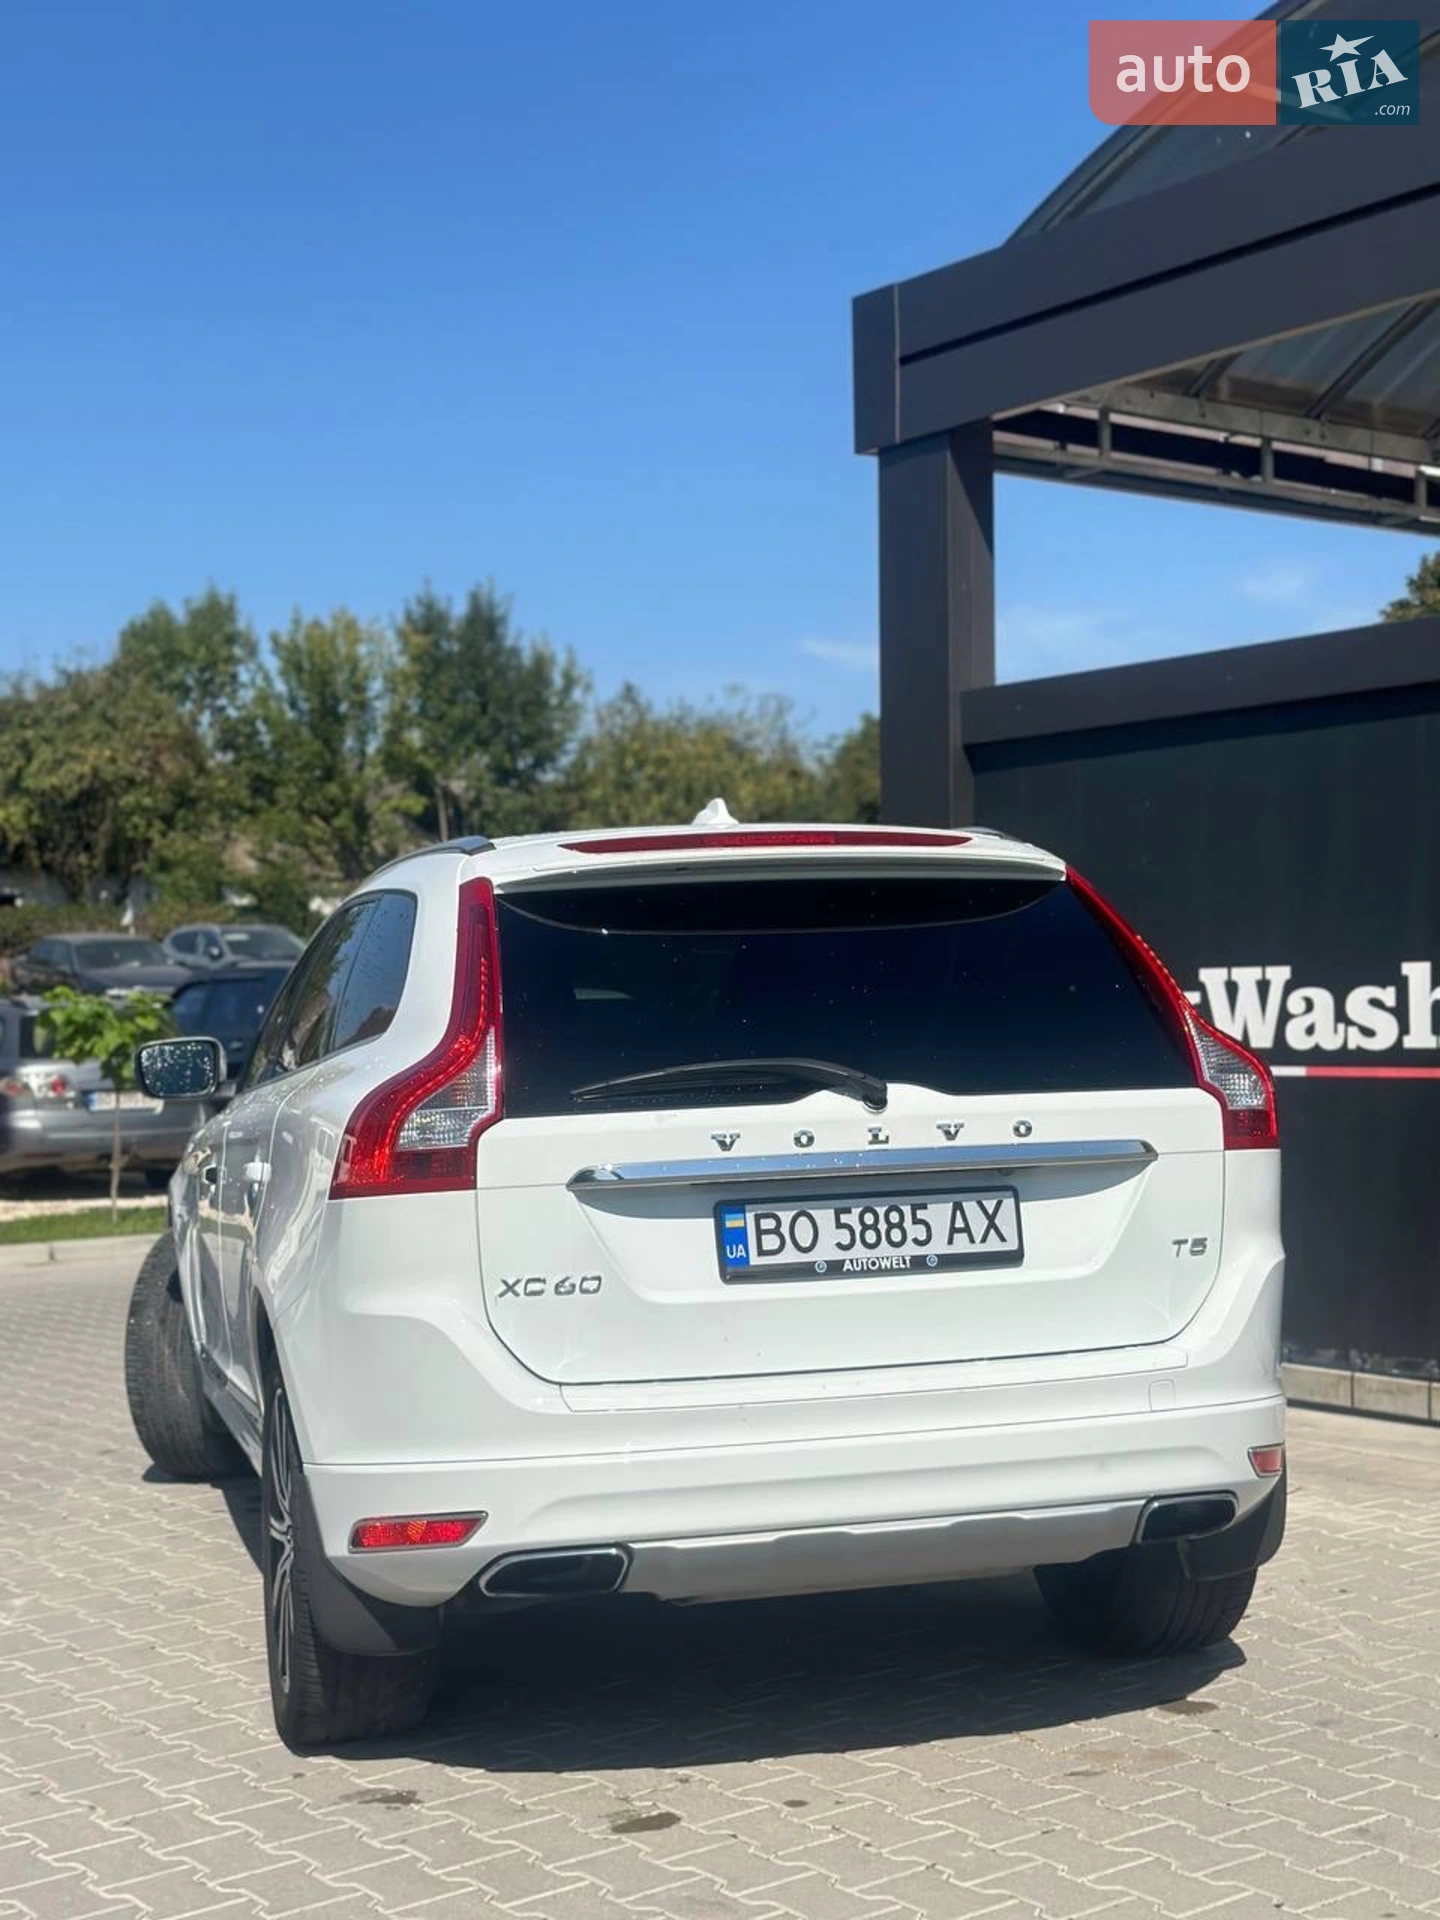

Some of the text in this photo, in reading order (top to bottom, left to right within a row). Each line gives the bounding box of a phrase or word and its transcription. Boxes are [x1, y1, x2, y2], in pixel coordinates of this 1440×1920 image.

[1183, 960, 1440, 1051] Wash
[710, 1119, 1034, 1152] VOLVO
[753, 1199, 1008, 1258] BO 5885 AX
[726, 1244, 747, 1260] UA
[1172, 1237, 1208, 1258] T5
[842, 1255, 912, 1273] AUTOWELT
